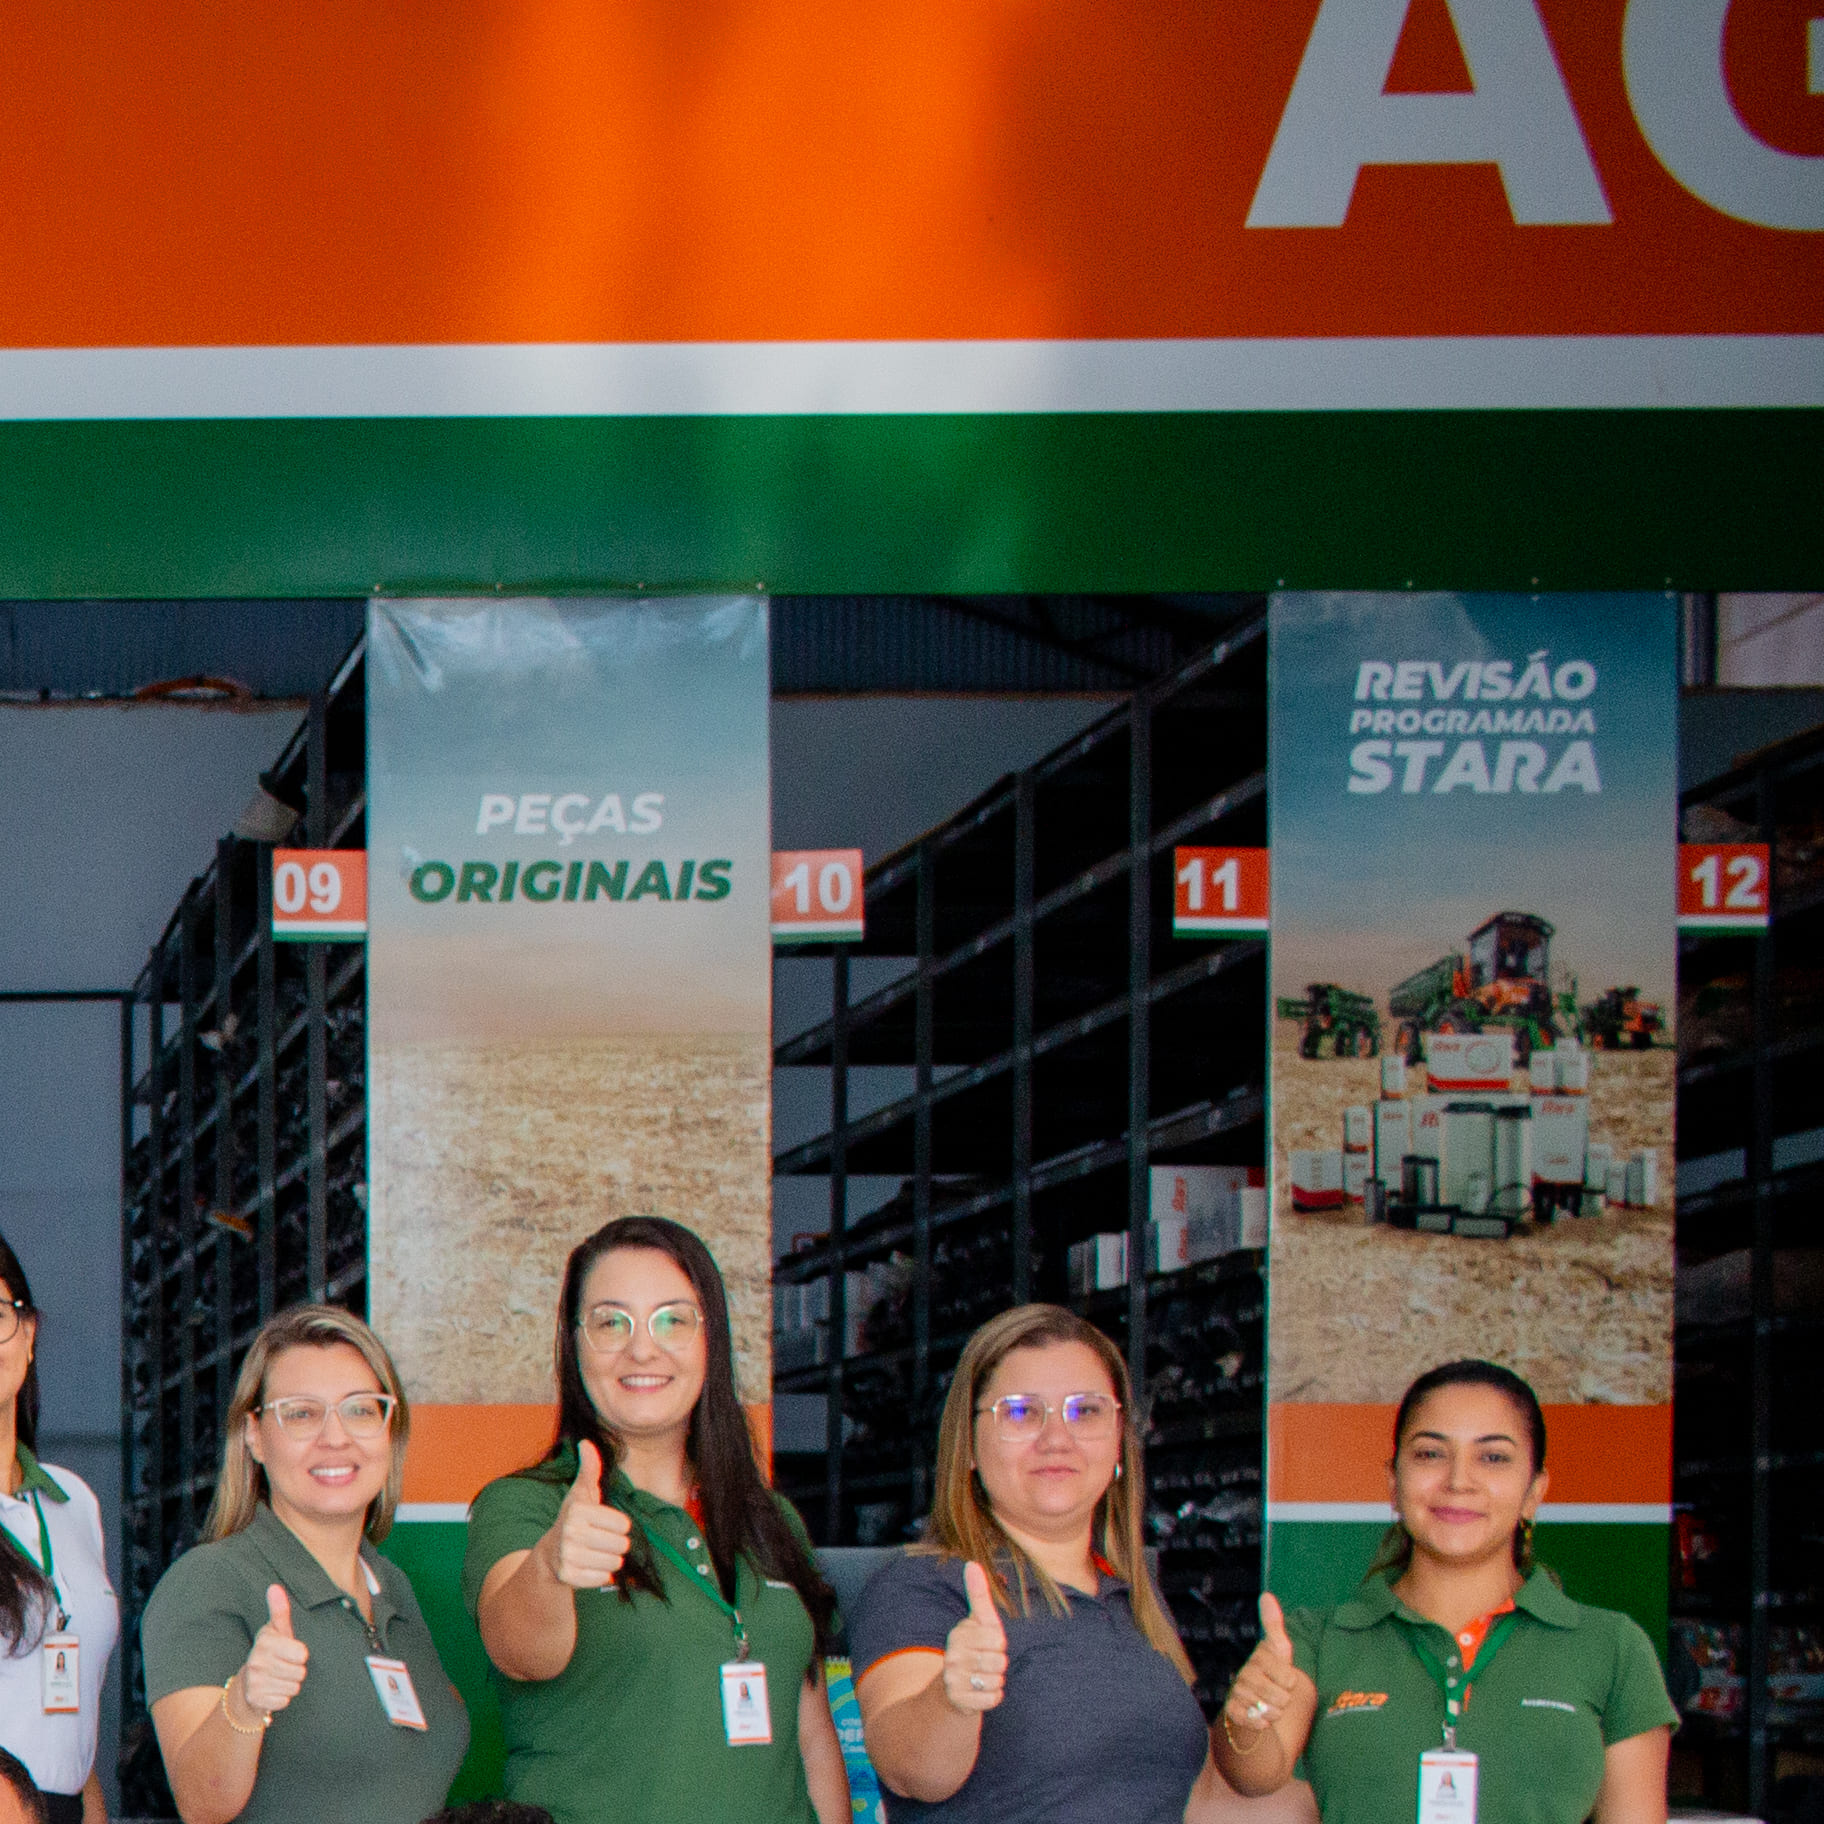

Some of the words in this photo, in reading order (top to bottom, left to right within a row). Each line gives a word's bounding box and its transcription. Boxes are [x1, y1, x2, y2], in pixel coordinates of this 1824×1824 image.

[1355, 650, 1598, 700] REVISÃO
[1350, 709, 1596, 734] PROGRAMADA
[1348, 740, 1602, 794] STARA
[476, 793, 664, 846] PEÇAS
[274, 862, 341, 913] 09
[409, 859, 733, 903] ORIGINAIS
[784, 862, 852, 914] 10
[1177, 858, 1240, 911] 11
[1692, 855, 1764, 909] 12
